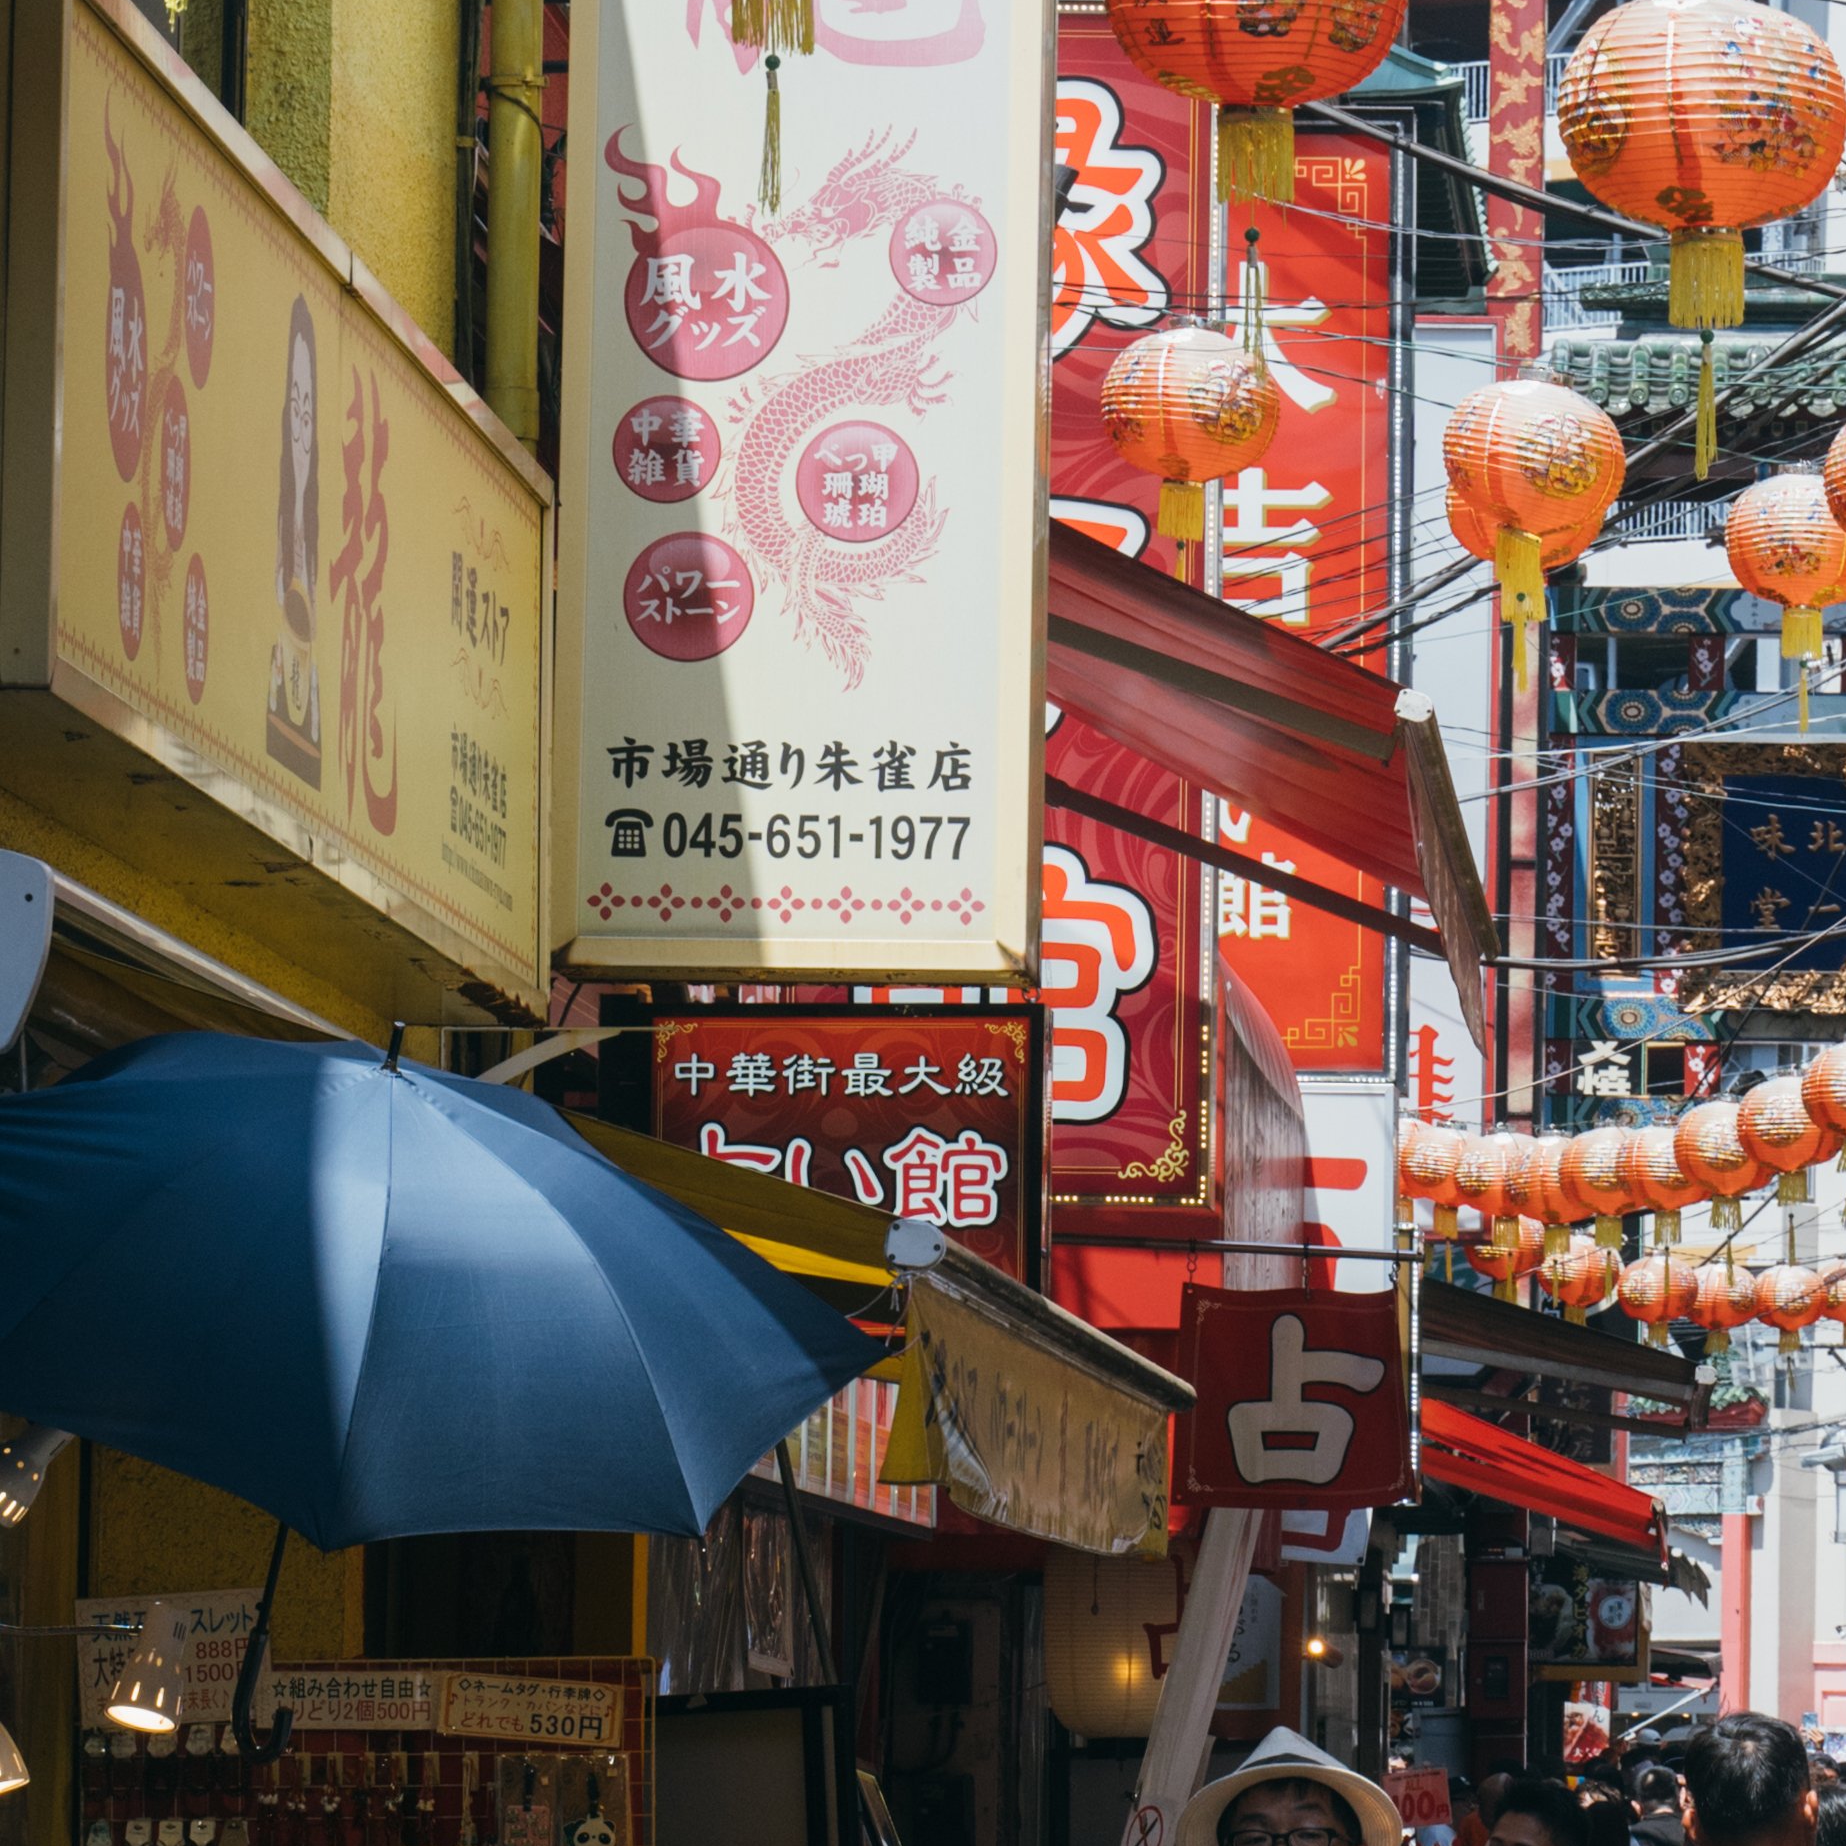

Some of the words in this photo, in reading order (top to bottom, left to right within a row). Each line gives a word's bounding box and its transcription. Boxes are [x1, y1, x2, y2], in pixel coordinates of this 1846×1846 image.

[639, 252, 773, 312] 風水
[109, 286, 145, 384] 風水
[644, 308, 769, 351] グッズ
[629, 408, 706, 448] 中華
[812, 441, 899, 471] べっ甲
[637, 565, 741, 594] パワー
[636, 595, 742, 627] ストーン
[606, 735, 972, 793] 市場通り朱雀店
[662, 811, 972, 861] 045-651-1977
[672, 1052, 1010, 1099] 中華街最大級
[1226, 1312, 1387, 1487] 占
[288, 1676, 415, 1700] 組み合わせ自由
[278, 1699, 432, 1722] りどり2個500円
[460, 1711, 525, 1733] どれでも
[529, 1712, 604, 1741] 530円
